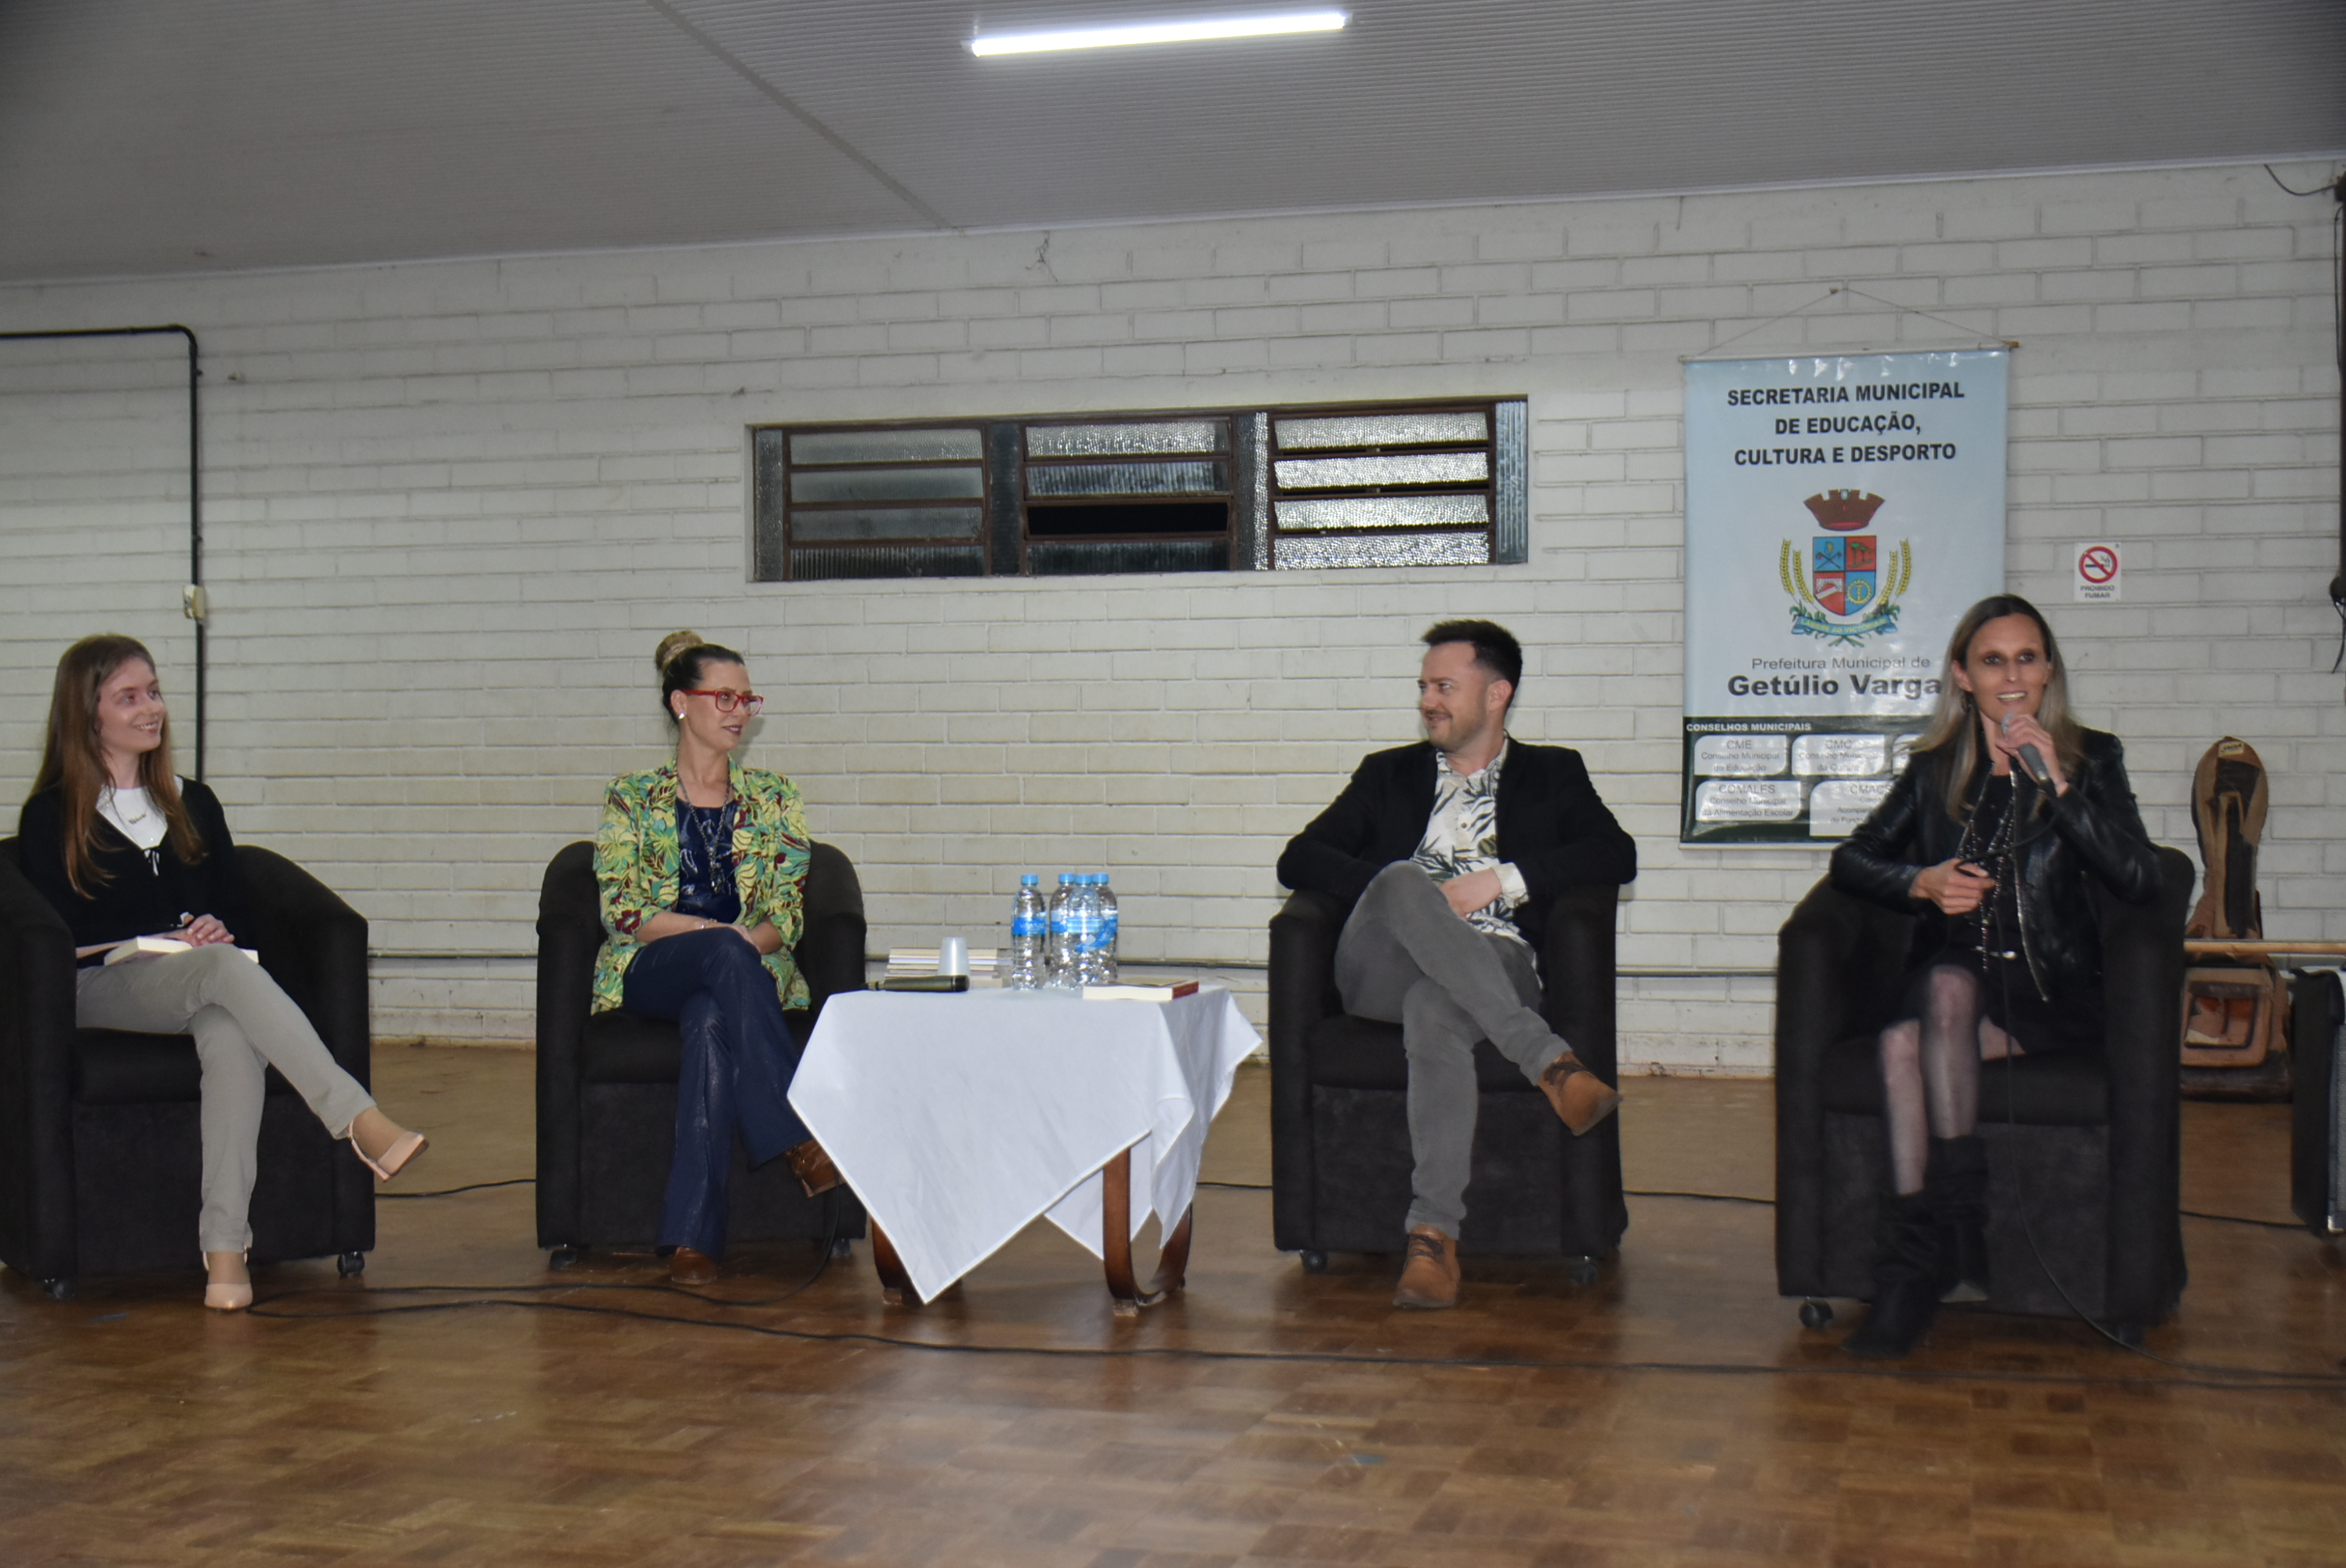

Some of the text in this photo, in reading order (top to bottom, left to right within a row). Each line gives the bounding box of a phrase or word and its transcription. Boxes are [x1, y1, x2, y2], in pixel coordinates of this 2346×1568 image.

[1727, 382, 1964, 406] SECRETARIA MUNICIPAL
[1775, 411, 1921, 435] DE EDUCAÇÃO,
[1734, 443, 1956, 465] CULTURA E DESPORTO
[1752, 656, 1930, 670] Prefeitura Municipal de
[1727, 673, 1942, 699] Getúlio Varga
[1751, 722, 1812, 731] MUNICIPAIS
[1727, 740, 1752, 750] CME
[1825, 739, 1852, 749] CMC
[1741, 752, 1779, 760] Municipal
[1714, 808, 1763, 818] Alimentação
